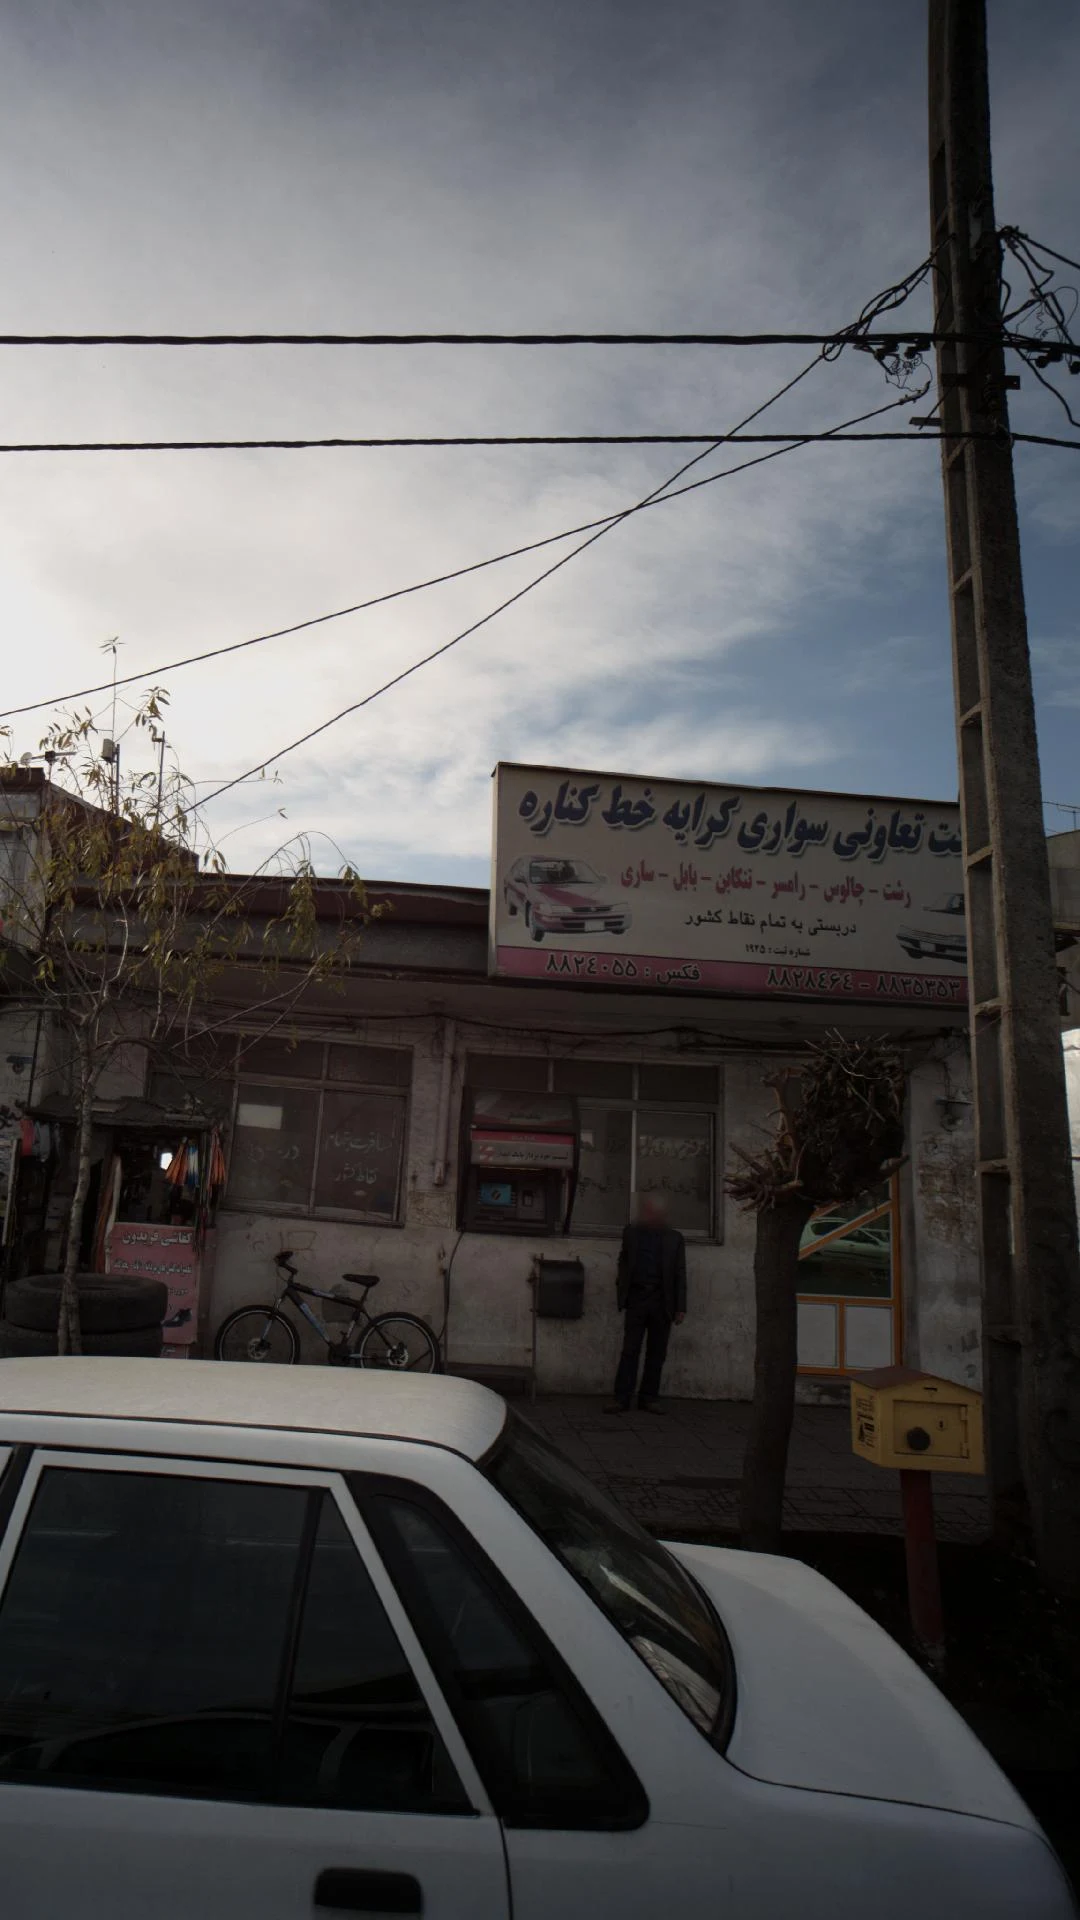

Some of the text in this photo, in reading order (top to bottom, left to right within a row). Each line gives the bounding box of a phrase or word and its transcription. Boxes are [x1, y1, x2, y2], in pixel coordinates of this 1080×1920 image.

[518, 779, 601, 834] کناره
[601, 783, 656, 828] خط
[662, 791, 741, 847] کرایه
[737, 799, 829, 855] سواری
[833, 807, 924, 860] تعاونی
[620, 859, 655, 889] ساری
[672, 861, 698, 891] بابل
[715, 864, 753, 895] تنکابن
[770, 871, 806, 901] رامسر
[823, 875, 865, 908] چالوس
[883, 880, 911, 908] رشت
[684, 909, 857, 937] دربستی به تمام نقاط کشور
[788, 945, 811, 957] شماره
[656, 963, 701, 985] فکس
[122, 1230, 193, 1247] کفاشی فریدون
